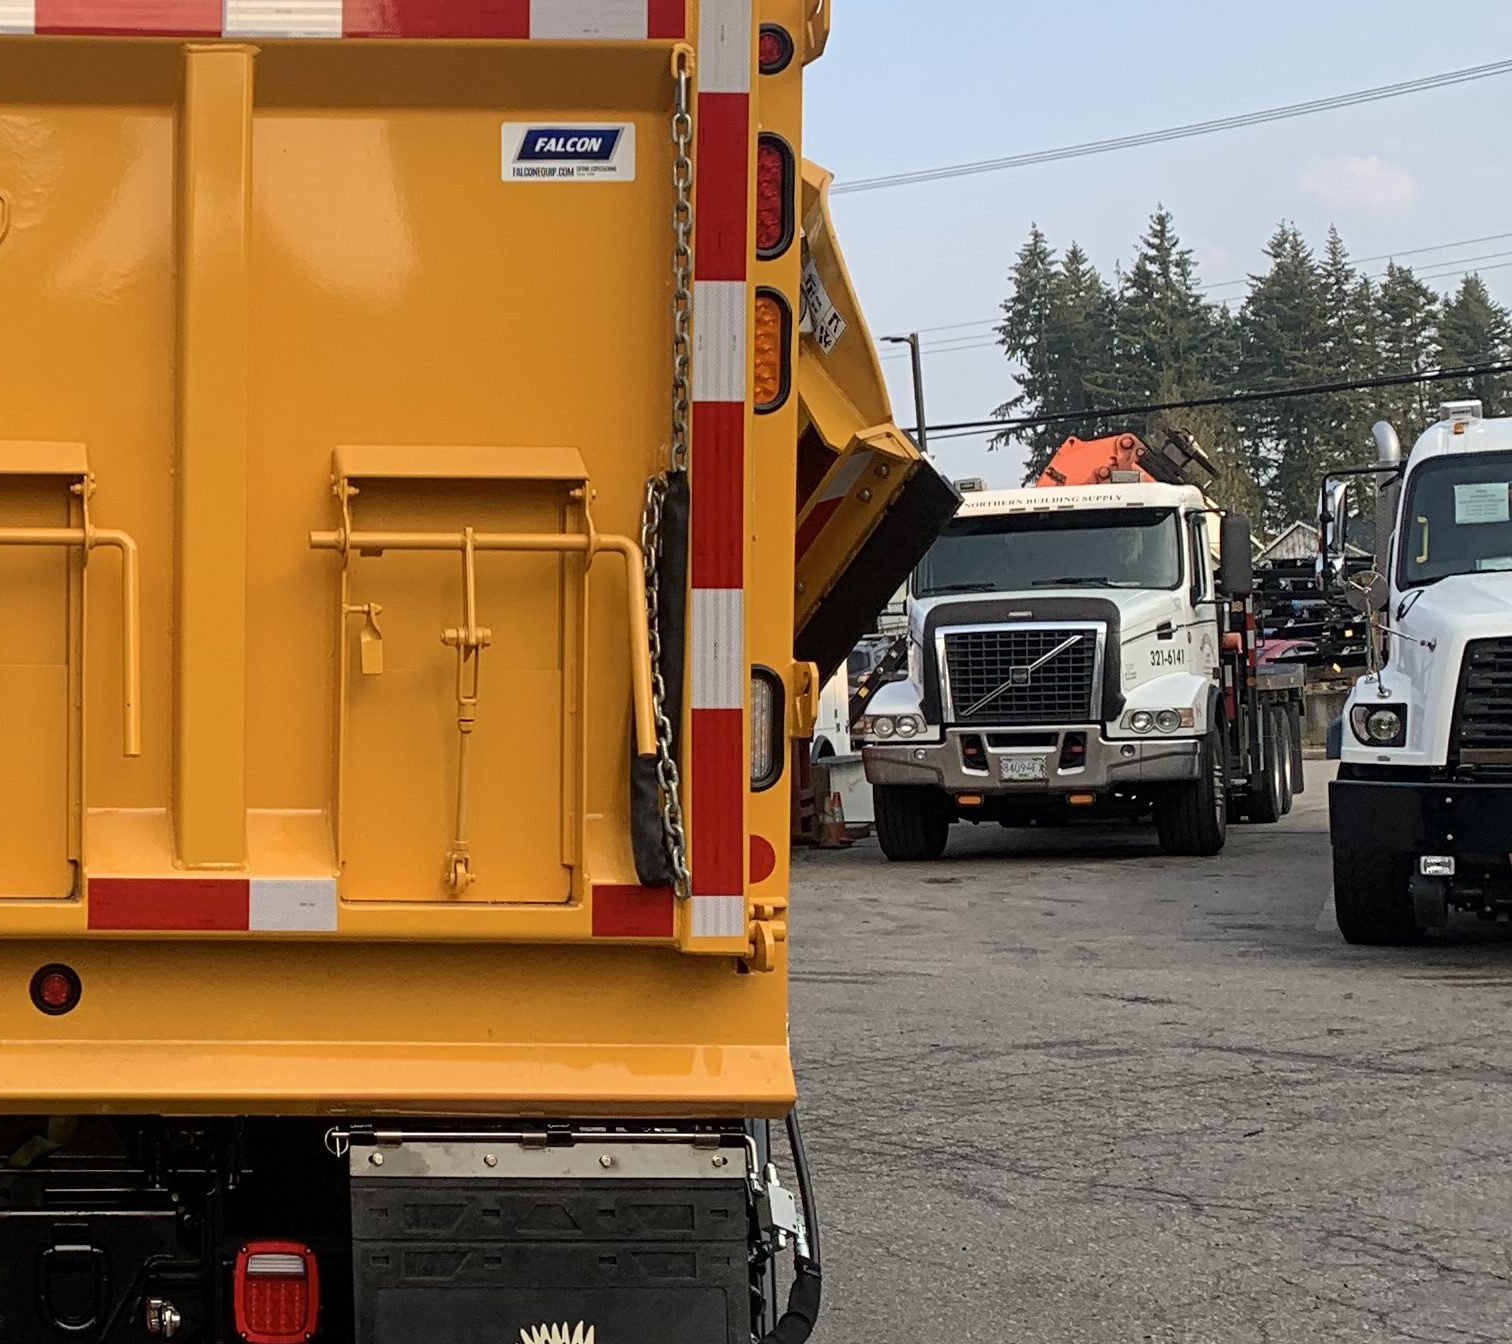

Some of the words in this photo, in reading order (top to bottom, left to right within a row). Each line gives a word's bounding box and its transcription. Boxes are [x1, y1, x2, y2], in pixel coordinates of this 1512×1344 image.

[534, 137, 602, 152] FALCON
[964, 499, 1023, 508] NORTHERN
[1026, 496, 1079, 504] BUILDING
[1082, 494, 1122, 502] SUPPLY
[1150, 649, 1185, 666] 321-6141
